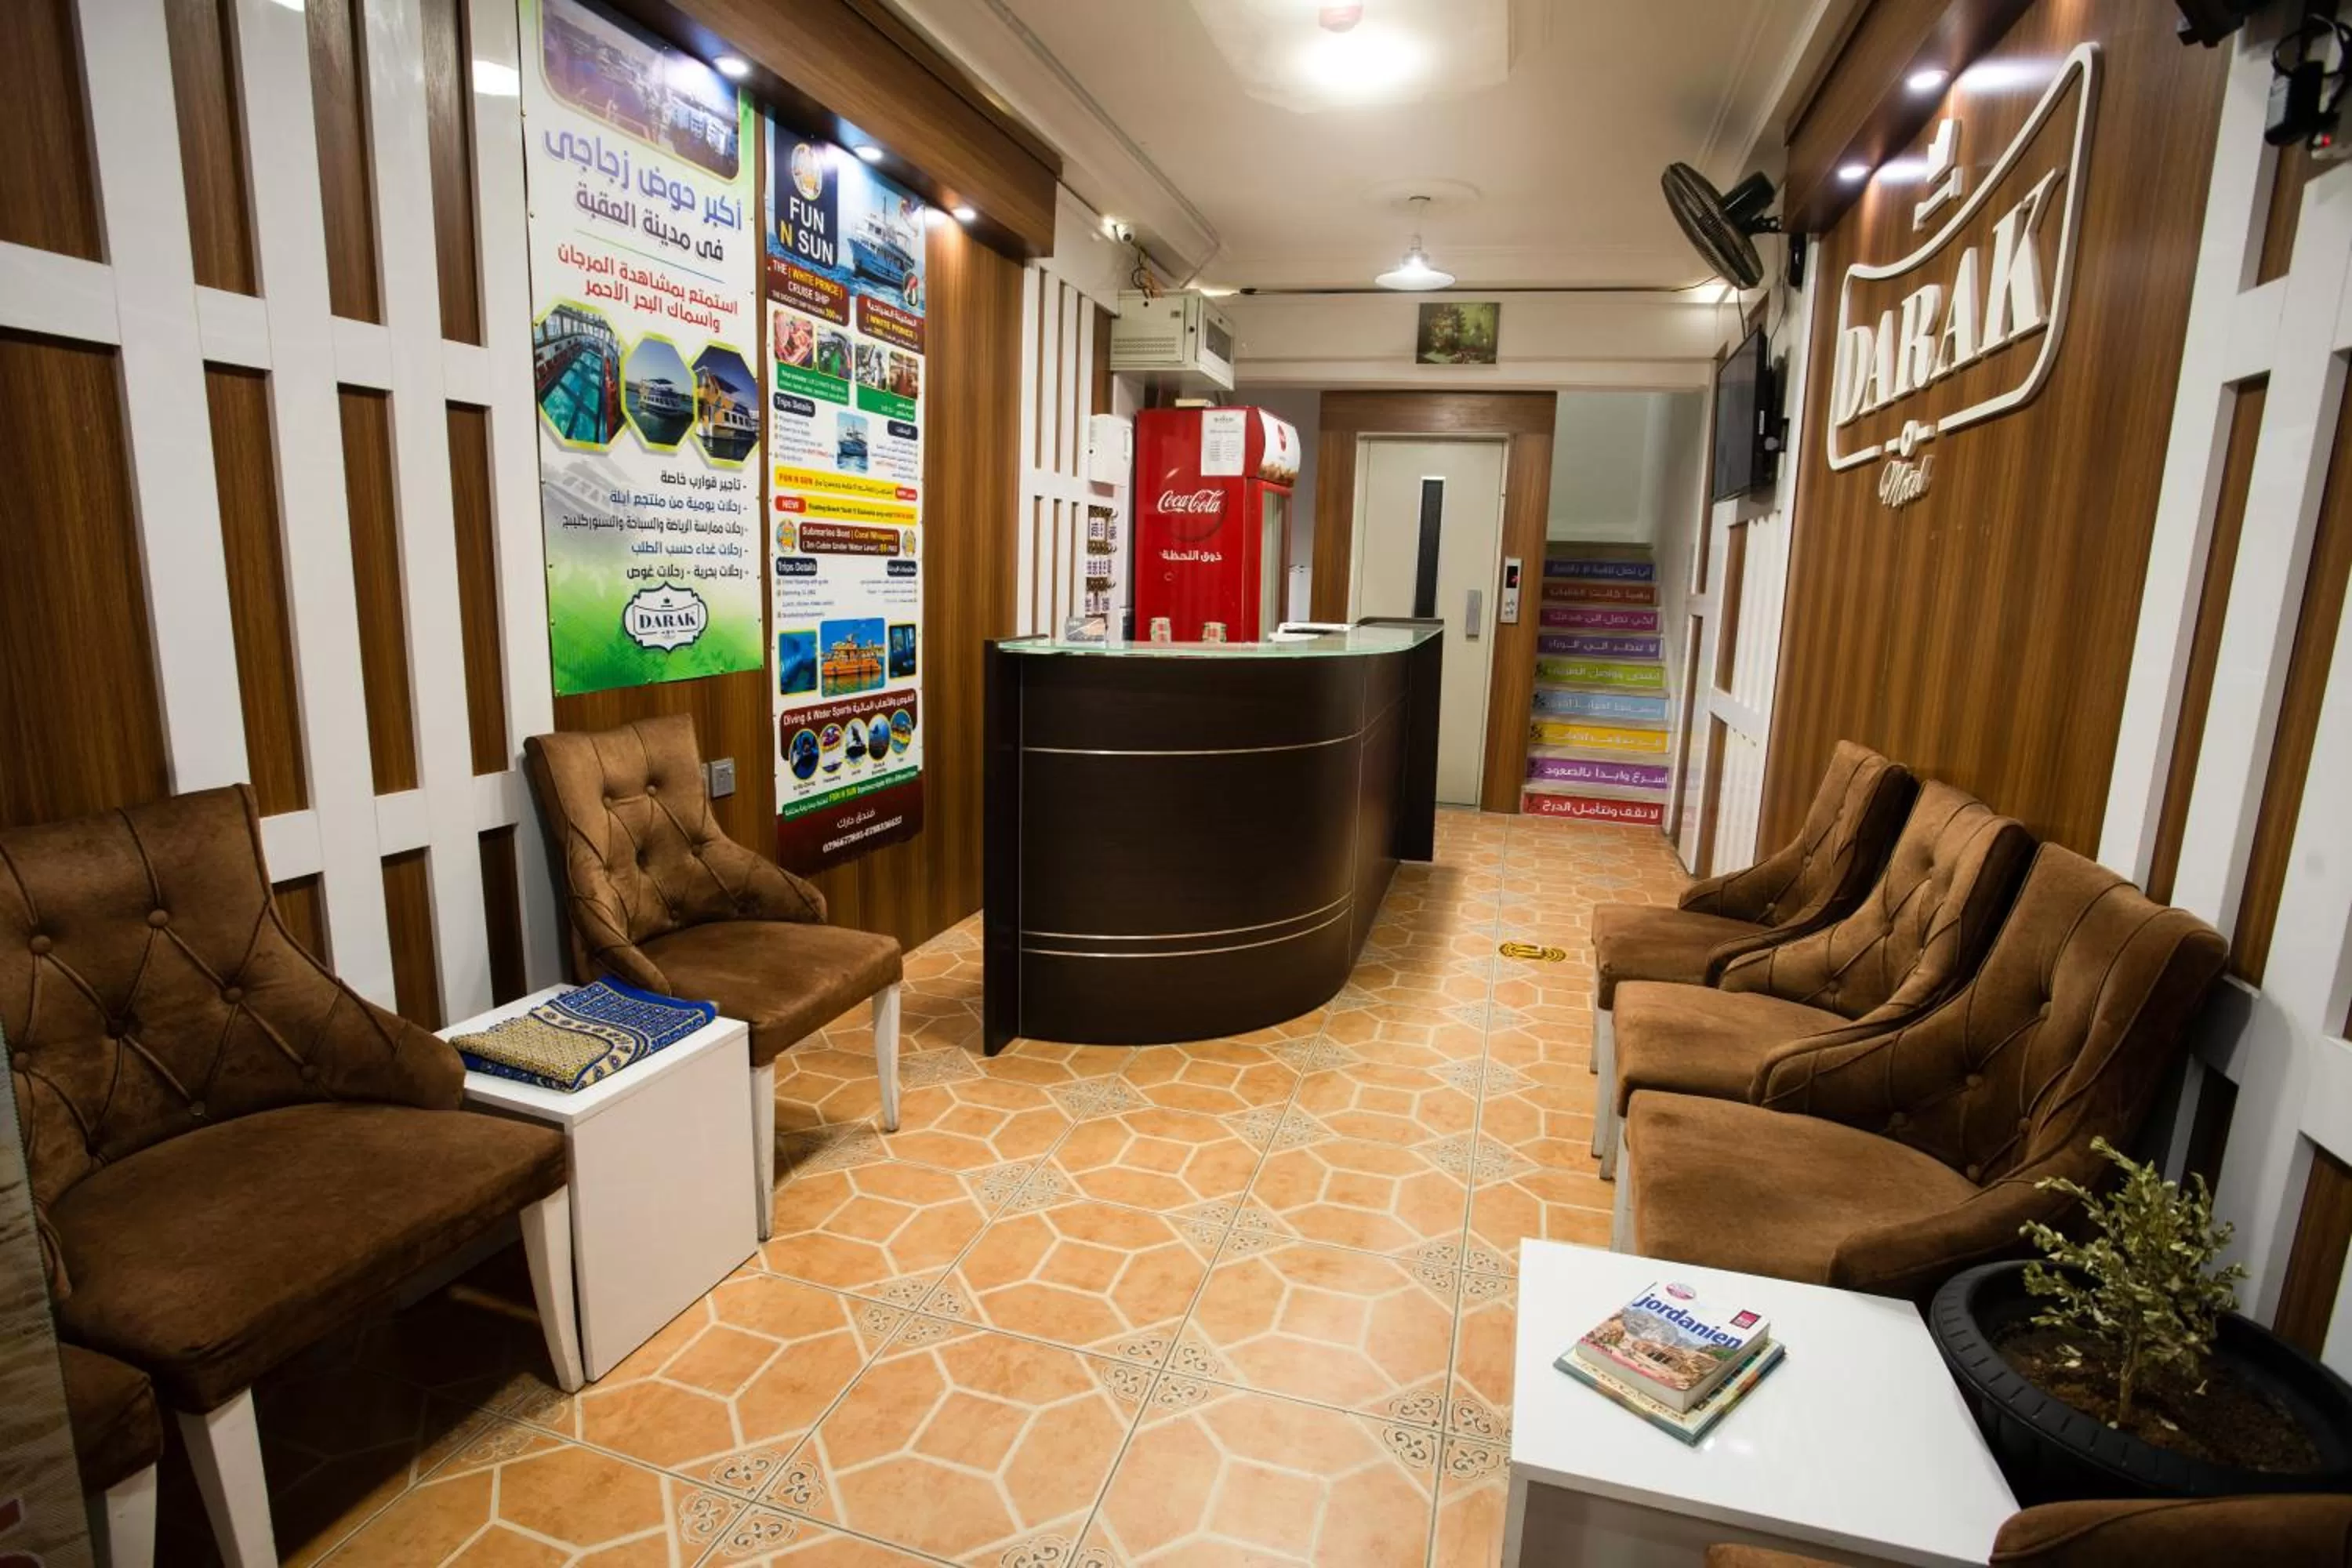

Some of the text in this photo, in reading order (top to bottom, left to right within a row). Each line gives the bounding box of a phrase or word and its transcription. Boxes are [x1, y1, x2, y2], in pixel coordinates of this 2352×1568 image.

[637, 165, 696, 212] حوض
[575, 181, 637, 228] العقبة
[703, 195, 742, 230] أكبر
[789, 196, 825, 234] FUN
[642, 208, 691, 251] مدينة
[779, 219, 833, 266] N SUN
[772, 259, 788, 275] THE
[557, 243, 738, 314] استمتع بمشاهدة المرجان
[633, 292, 663, 314] البحر
[1835, 166, 2067, 427] DARAK
[660, 470, 686, 485] خاصة
[689, 474, 717, 490] قوارب
[669, 495, 684, 509] من
[686, 496, 716, 513] يومية
[717, 499, 742, 515] رحلات
[1156, 489, 1225, 515] Coca-Cola
[666, 518, 692, 534] الرياضة
[694, 520, 724, 535] ممارسة
[631, 541, 742, 558] رحلات غداء حسب الطلب
[1162, 549, 1200, 561] اللحظة
[626, 564, 743, 580] رحلات بحرية رحلات غوص
[639, 612, 696, 629] DARAK
[783, 713, 805, 727] Diving
[806, 711, 812, 722] &
[1544, 766, 1592, 778] بالصعود
[1541, 799, 1571, 812] الدرج
[1650, 808, 1659, 819] لا
[1632, 1292, 1744, 1351] jordanien
